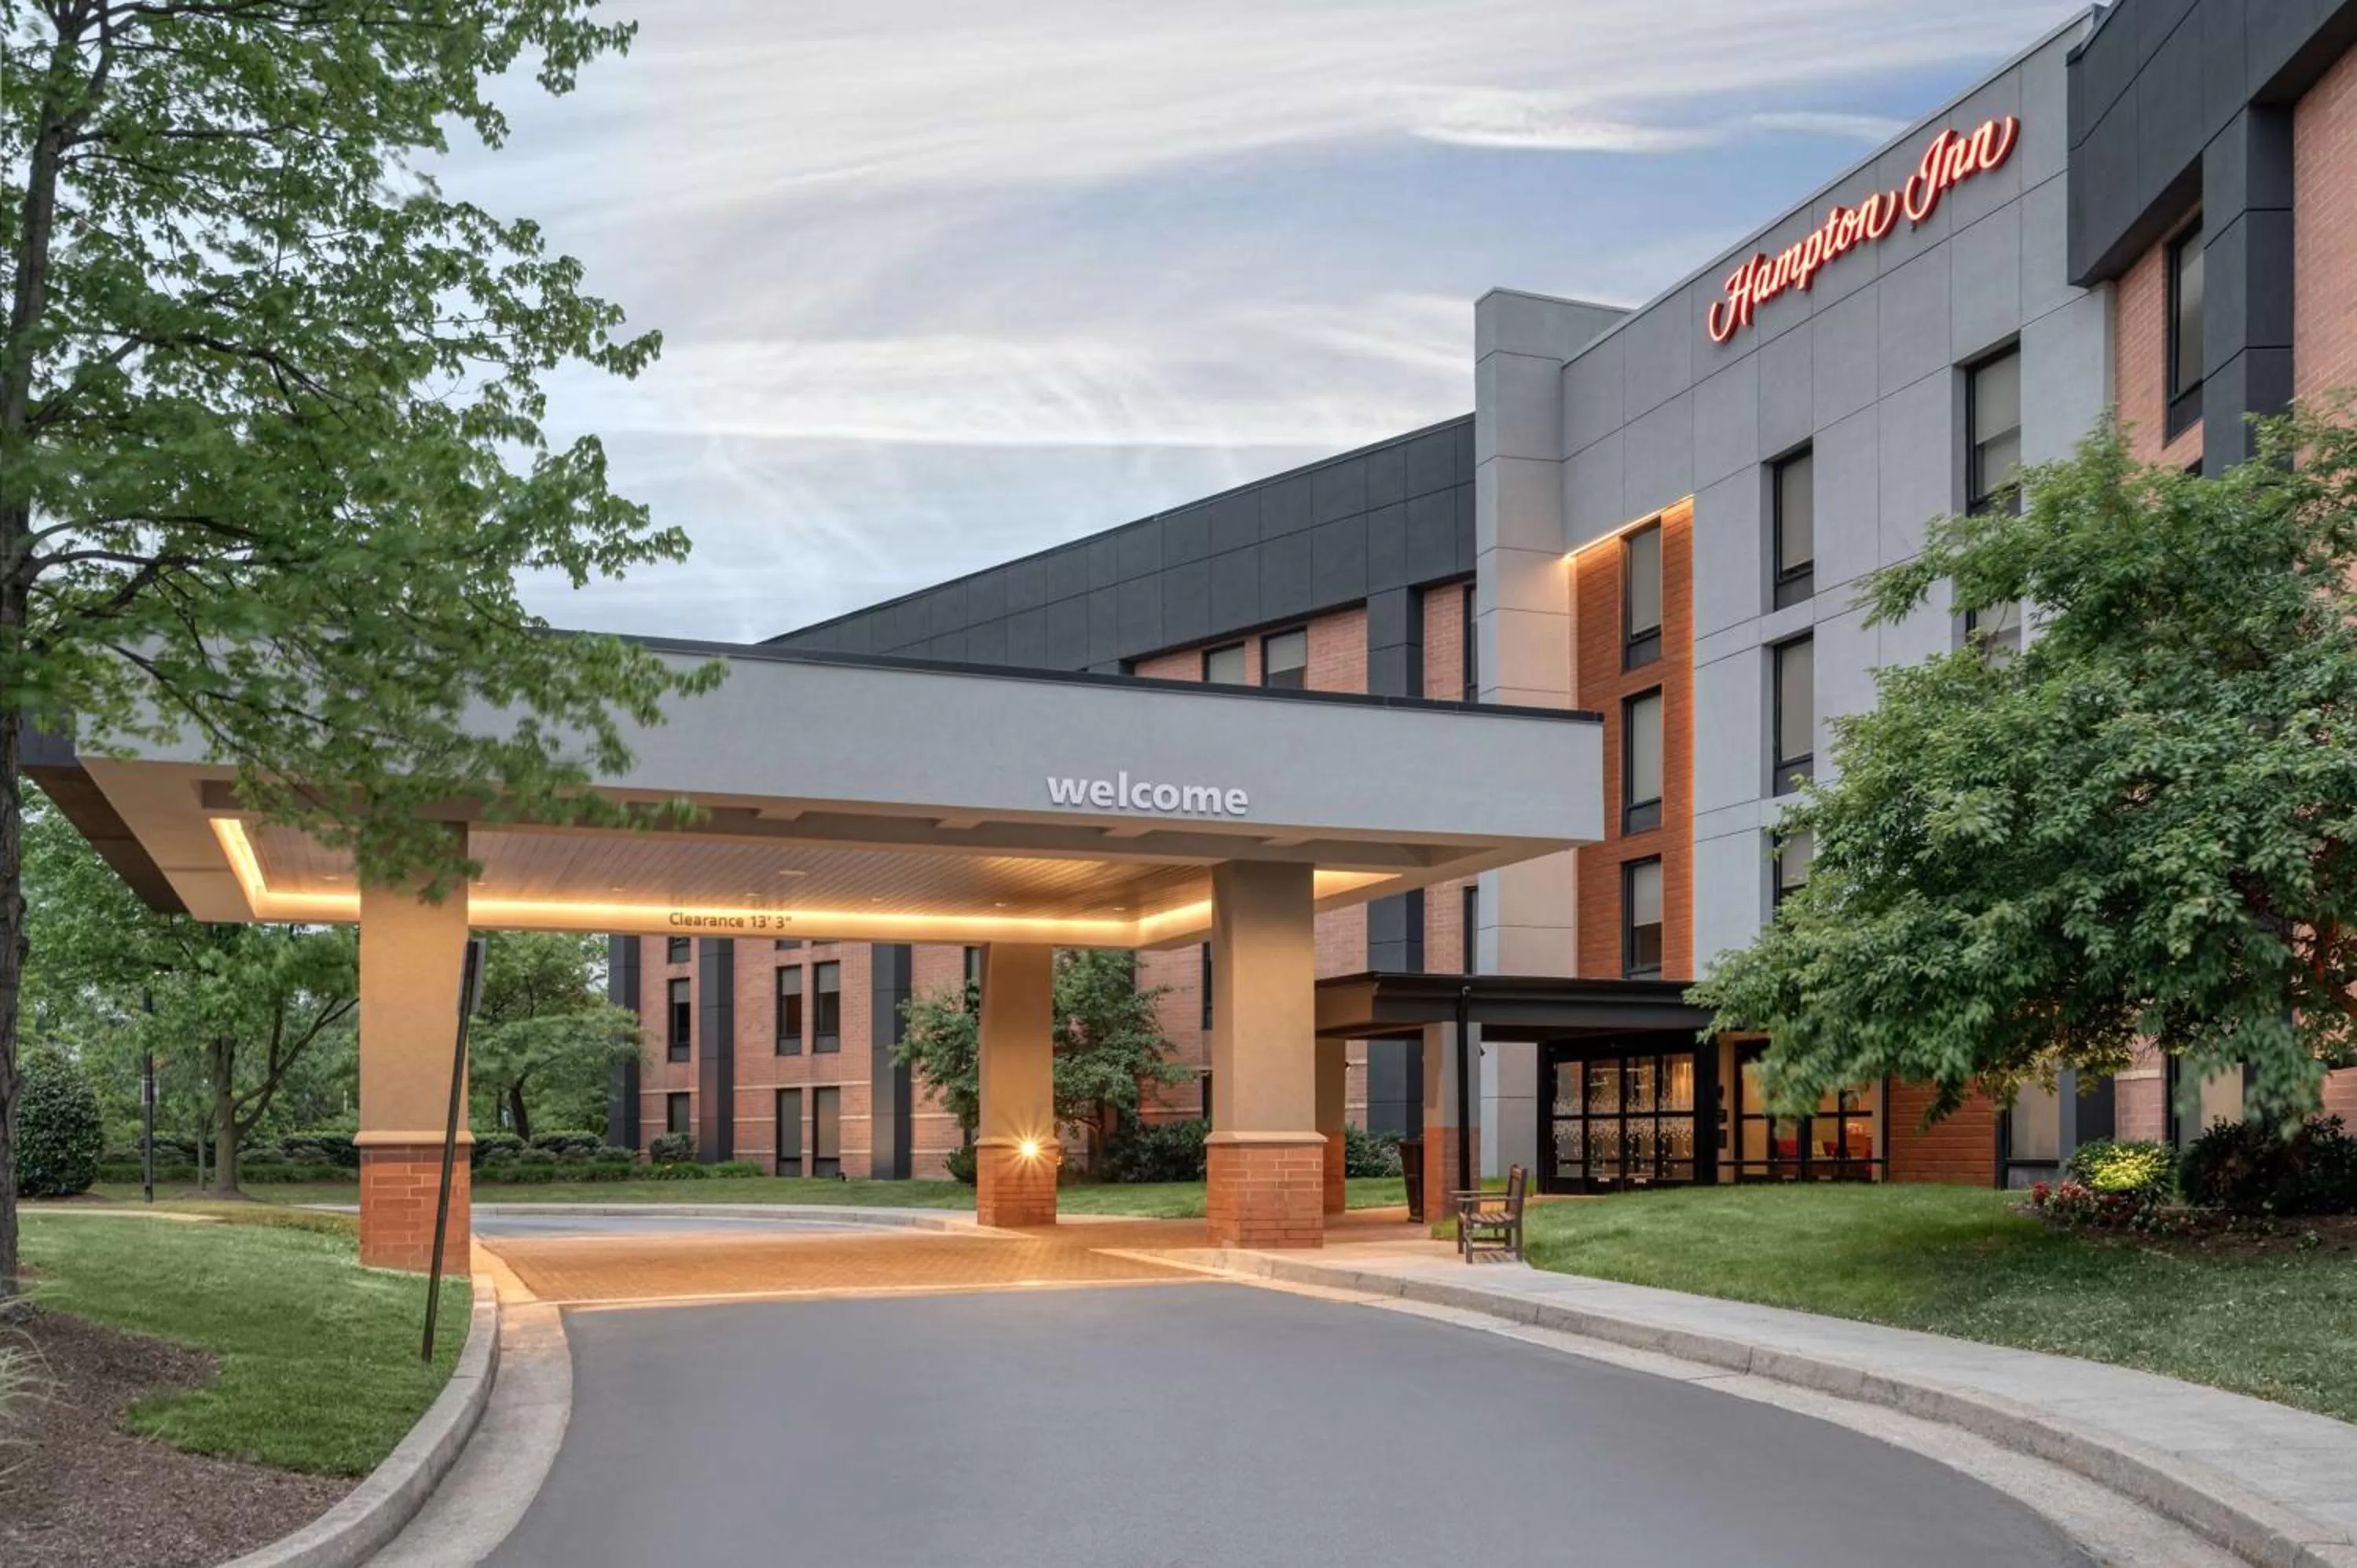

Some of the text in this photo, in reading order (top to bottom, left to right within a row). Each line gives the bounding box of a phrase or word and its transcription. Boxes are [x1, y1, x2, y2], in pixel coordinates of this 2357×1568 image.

[1709, 115, 2020, 343] Hampton Inn
[1047, 771, 1248, 815] welcome
[669, 912, 744, 928] Clearance
